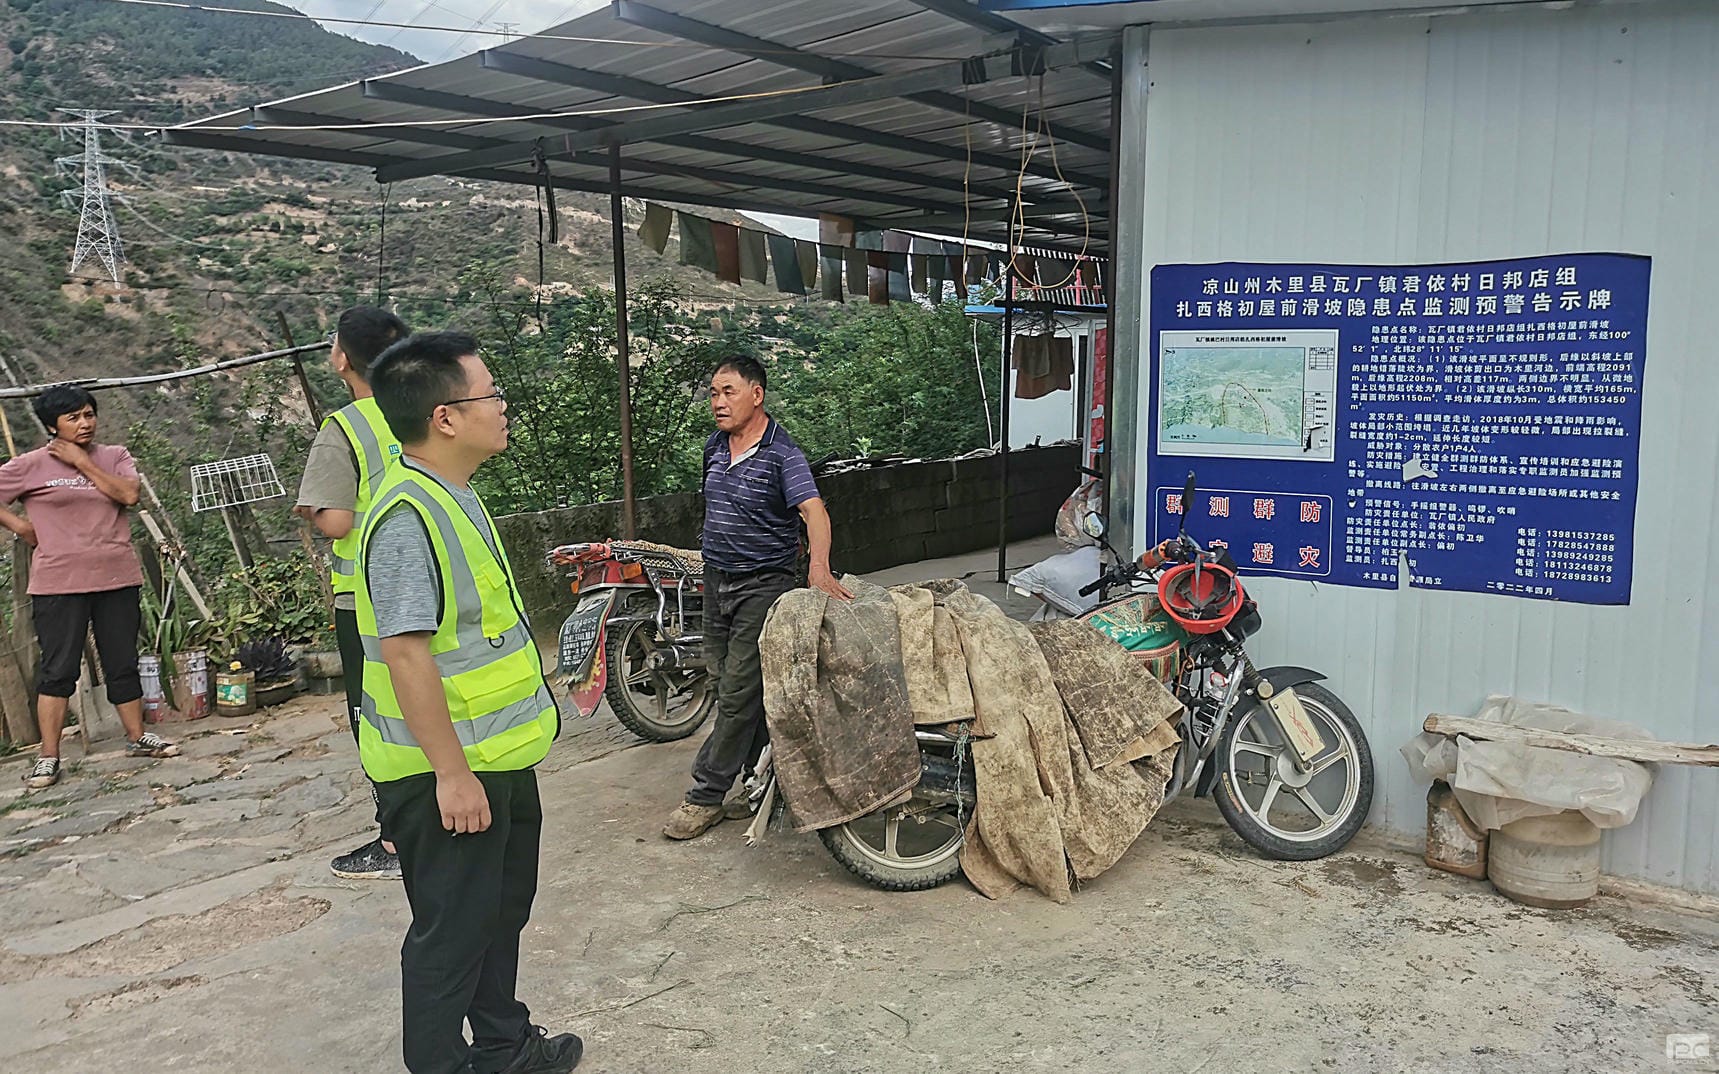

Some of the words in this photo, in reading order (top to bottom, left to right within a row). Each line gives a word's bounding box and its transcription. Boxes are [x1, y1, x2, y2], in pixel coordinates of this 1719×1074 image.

[1202, 266, 1577, 295] 凉山州木里县瓦厂镇君依村日邦店组
[1176, 289, 1612, 318] 扎西格初屋前滑坡隐患点监测预警告示牌
